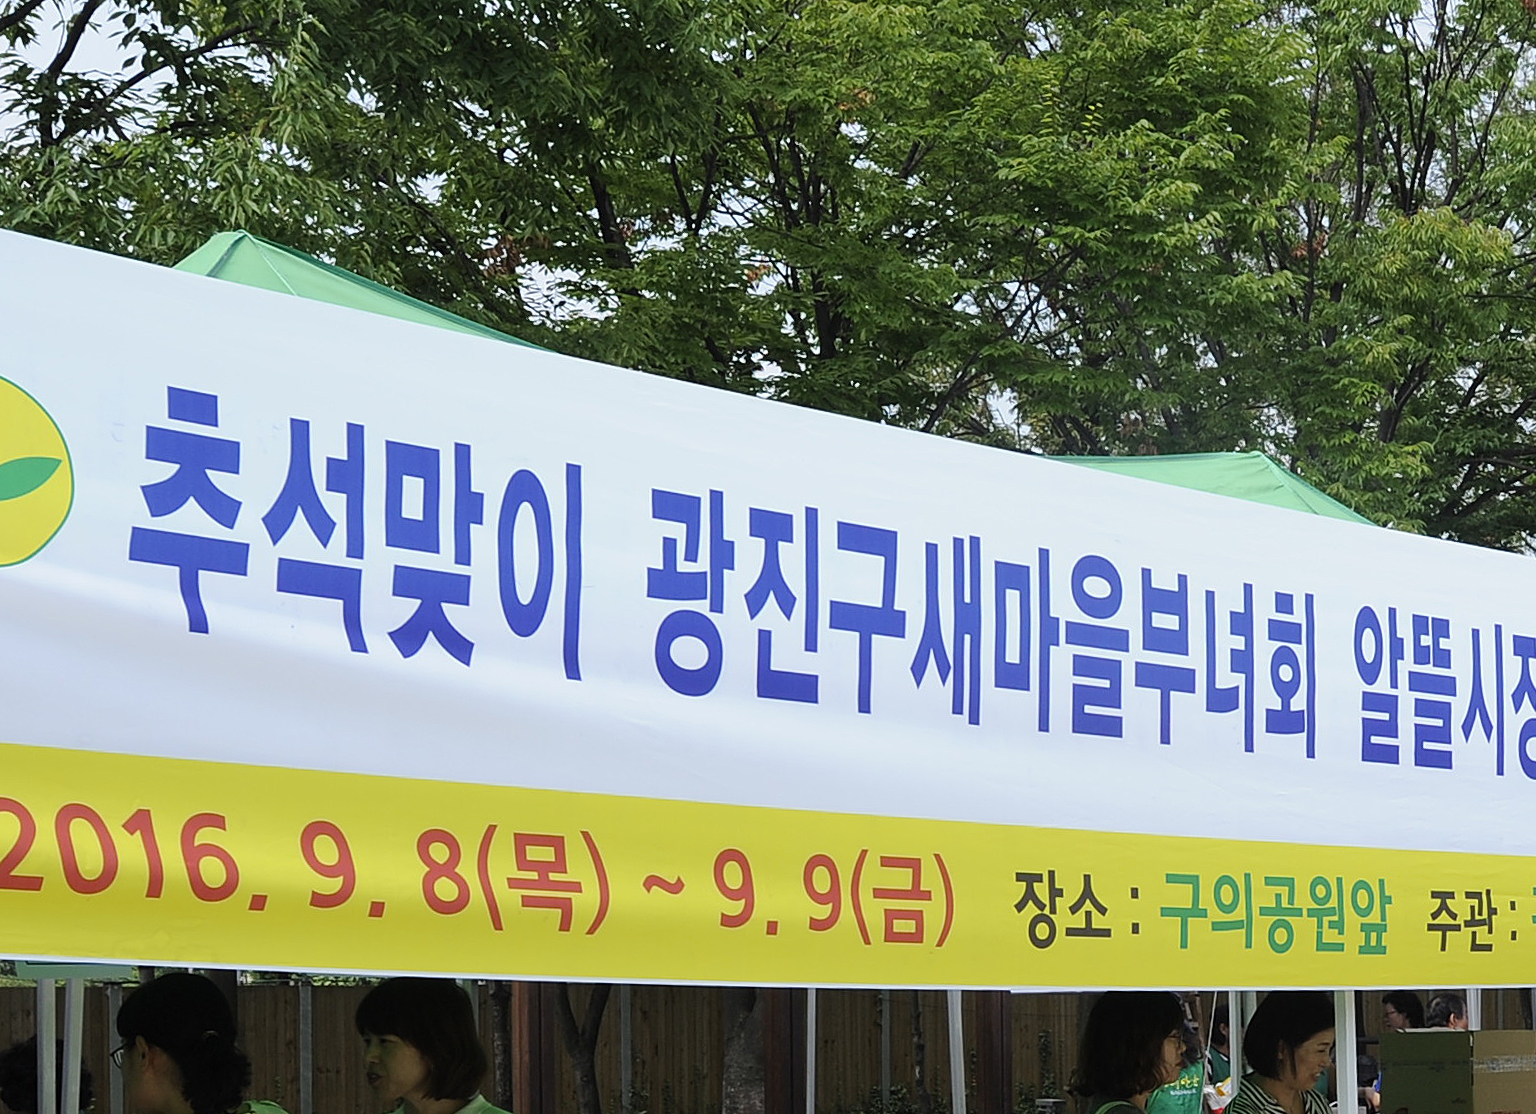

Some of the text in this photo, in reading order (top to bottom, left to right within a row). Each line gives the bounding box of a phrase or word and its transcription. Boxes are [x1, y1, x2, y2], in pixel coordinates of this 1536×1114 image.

[128, 384, 583, 683] 추석맞이
[646, 487, 1317, 760] 광진구새마을부녀회
[415, 823, 610, 935] 8(목)
[803, 848, 955, 948] 9(금)
[1159, 871, 1393, 956] 구의공원앞
